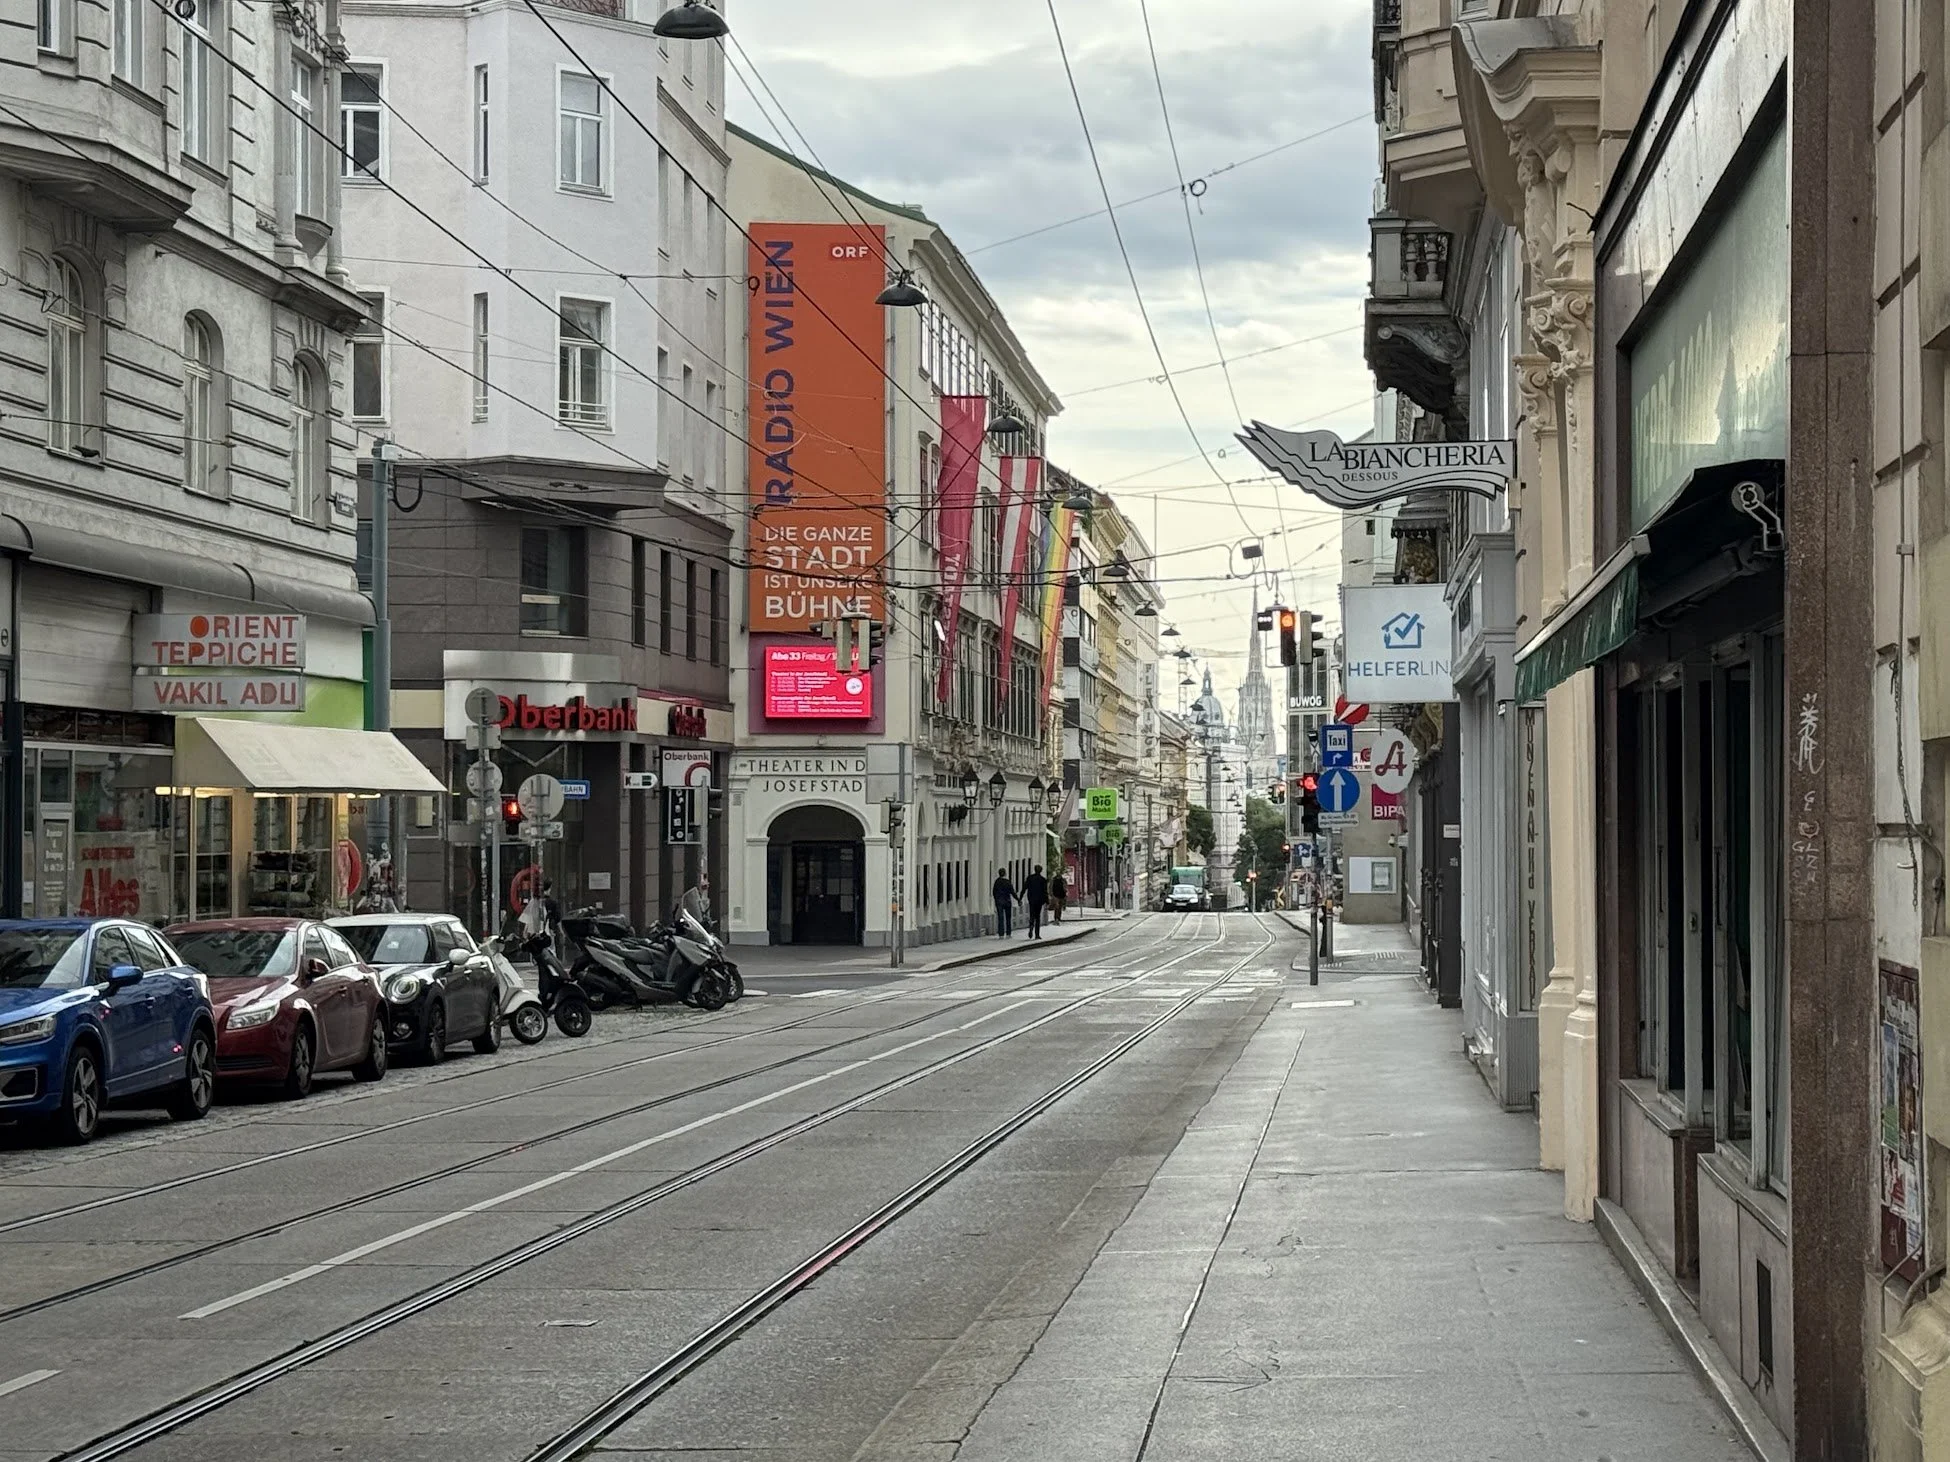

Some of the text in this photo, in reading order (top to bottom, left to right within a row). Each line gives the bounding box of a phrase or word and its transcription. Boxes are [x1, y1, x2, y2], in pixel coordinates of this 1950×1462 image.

[831, 245, 868, 259] ORF
[765, 240, 795, 505] RADIO WIEN
[1309, 441, 1505, 471] LA BIANCHERIA
[1341, 471, 1399, 483] DESSOUS
[765, 526, 873, 542] DIE GANZE
[766, 546, 873, 570] STADT
[765, 575, 793, 588] IST
[765, 591, 873, 619] BÜHNE
[189, 615, 299, 639] ORIENT
[152, 642, 298, 665] TEPPICHE
[1348, 660, 1452, 677] HELFERLIN
[154, 681, 228, 705] VAKIL
[1290, 695, 1322, 708] BUWOG
[493, 693, 637, 732] Oberbank
[1328, 735, 1346, 747] Taxi
[664, 752, 710, 761] Oberbank
[749, 759, 824, 772] THEATER
[831, 759, 848, 772] IN
[561, 785, 584, 793] BAHN
[763, 779, 865, 792] JOSEFSTAD
[1374, 805, 1405, 817] BIPA
